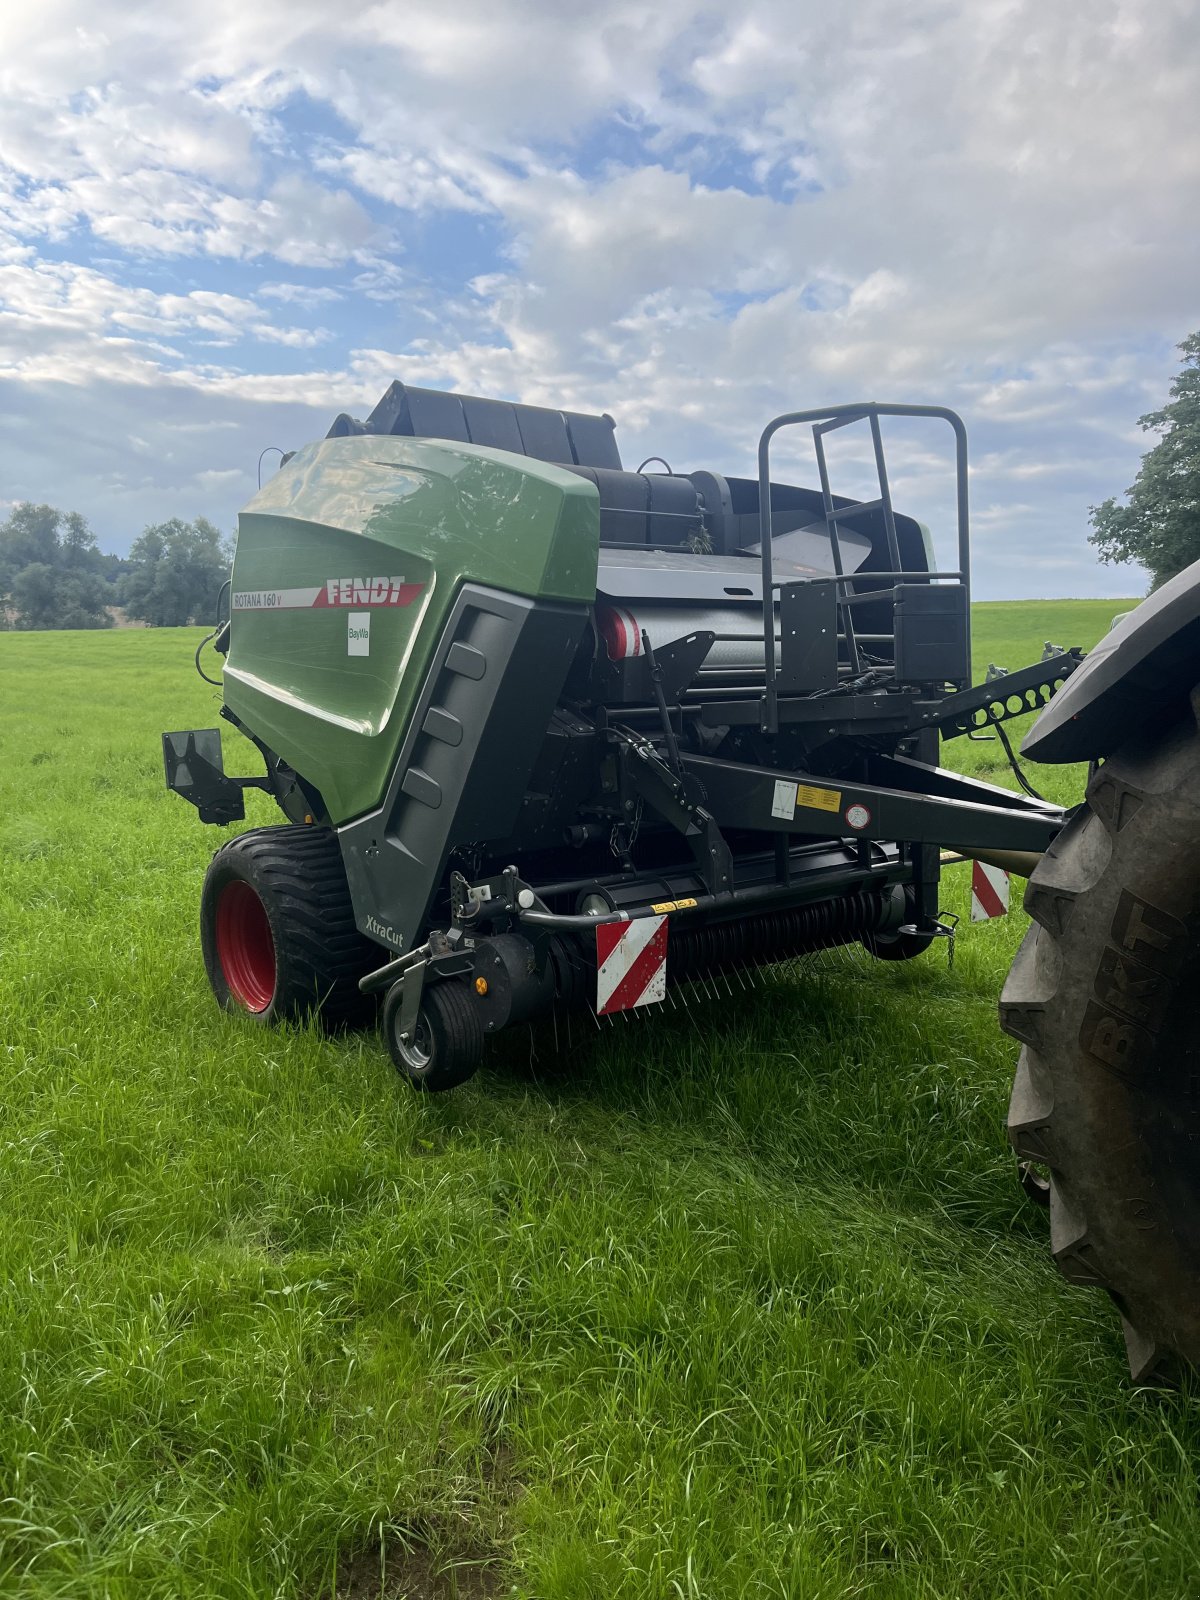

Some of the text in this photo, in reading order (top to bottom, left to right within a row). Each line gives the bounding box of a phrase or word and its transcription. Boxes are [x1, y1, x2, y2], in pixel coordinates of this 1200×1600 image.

[234, 593, 262, 608] ROTANA
[263, 593, 276, 606] 160
[326, 575, 405, 605] FENDT
[349, 628, 368, 640] BayWa
[365, 914, 404, 948] XtraCut
[1090, 901, 1176, 1076] BKT
